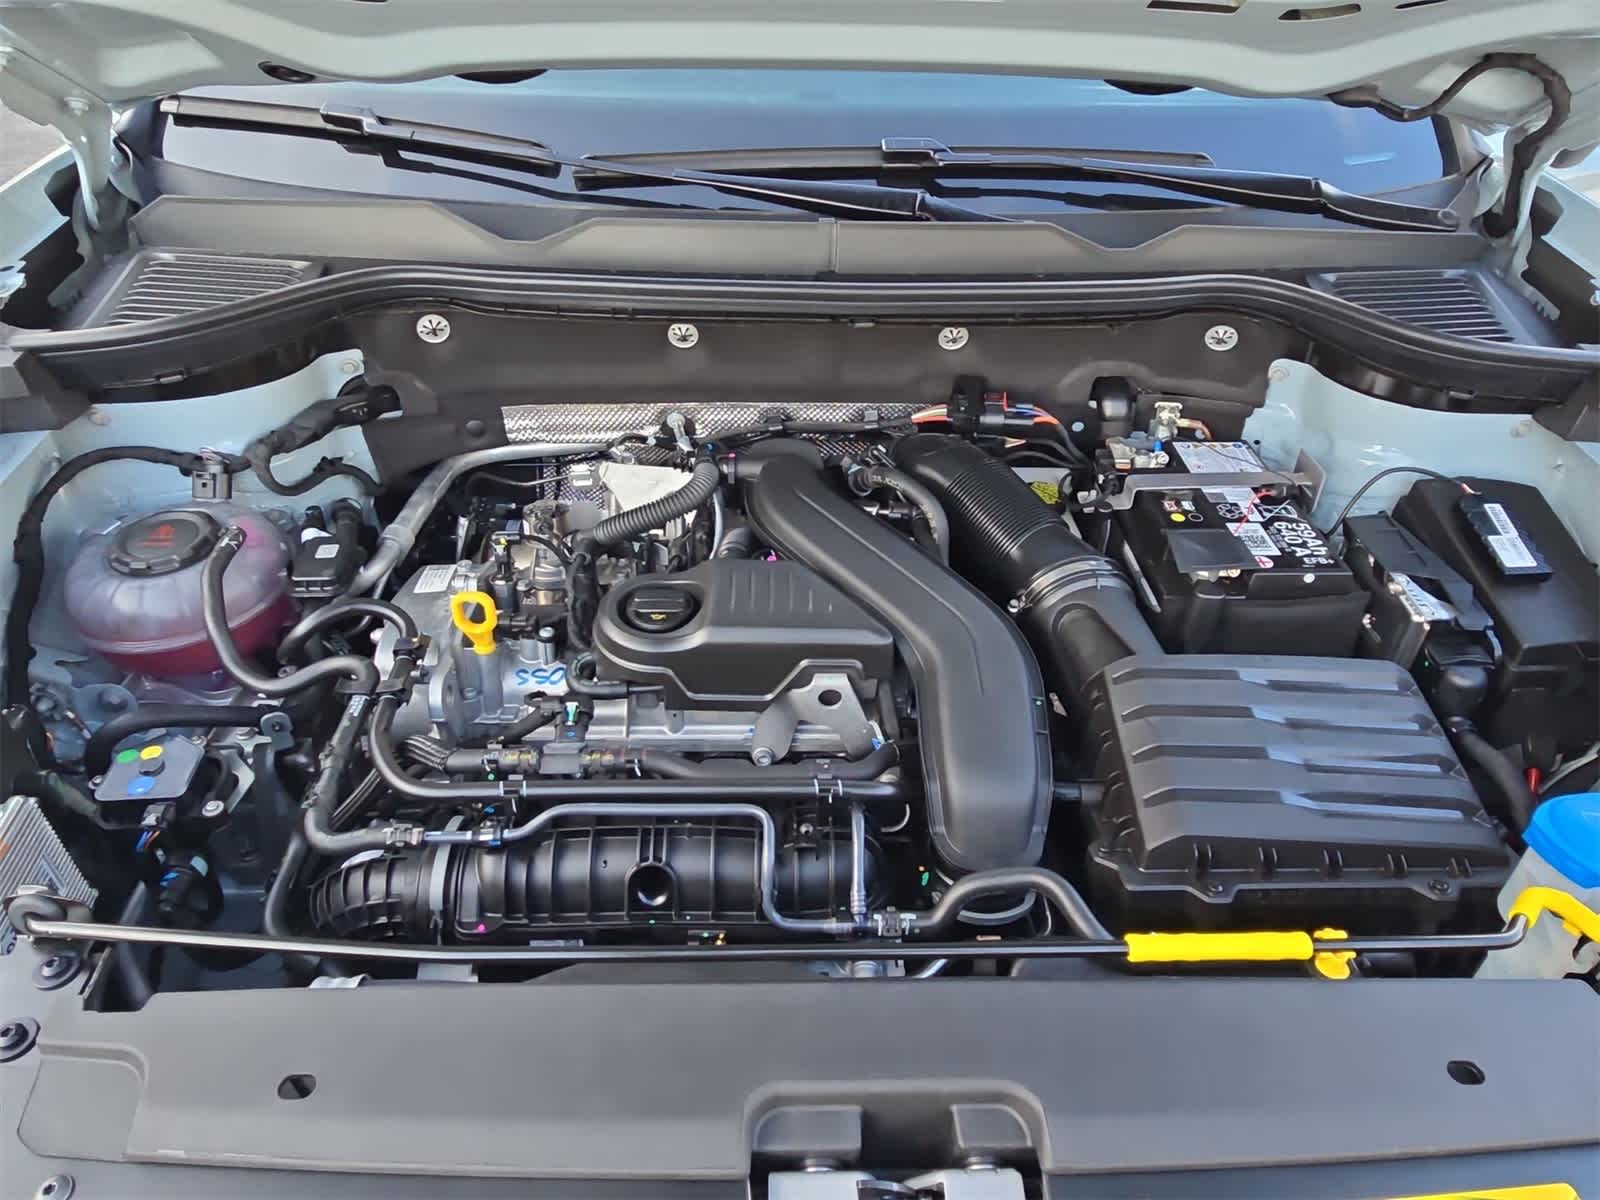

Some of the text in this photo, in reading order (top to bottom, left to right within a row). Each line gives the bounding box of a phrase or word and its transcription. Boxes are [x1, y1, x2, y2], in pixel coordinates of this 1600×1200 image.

[1273, 521, 1303, 545] 640
[1290, 546, 1312, 557] A
[1291, 522, 1329, 556] 59Ah
